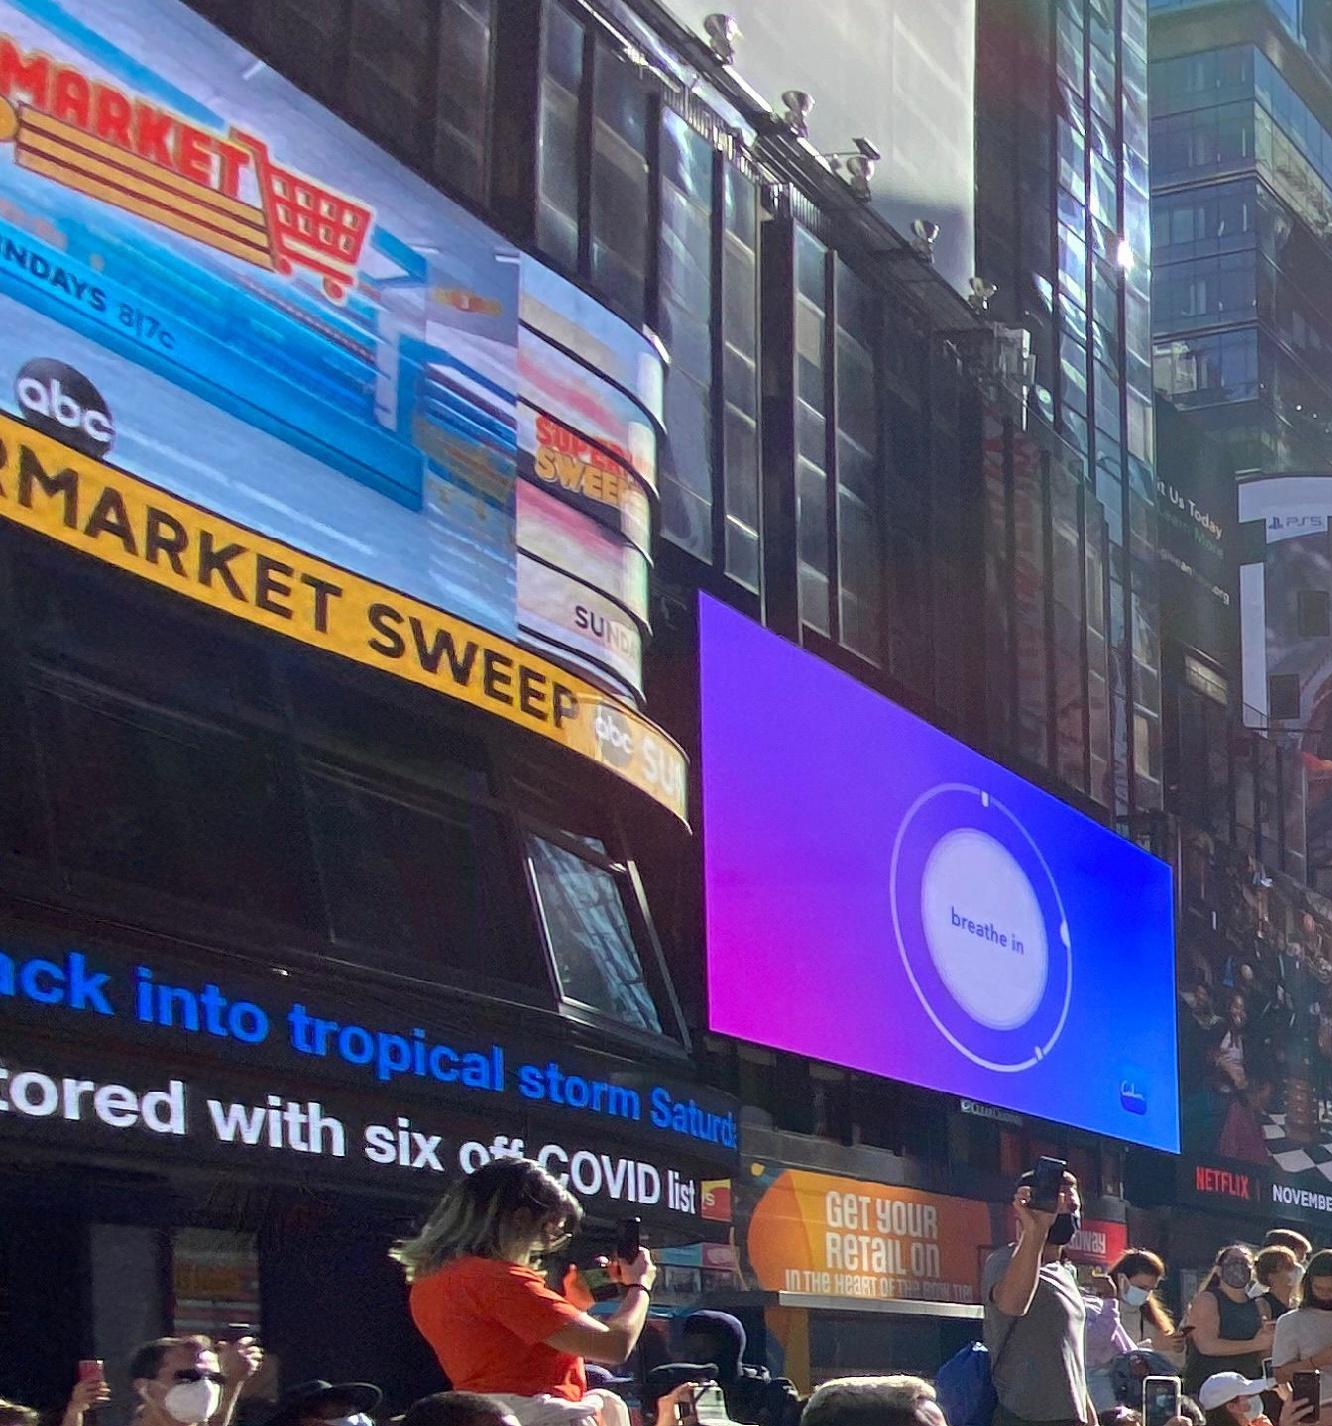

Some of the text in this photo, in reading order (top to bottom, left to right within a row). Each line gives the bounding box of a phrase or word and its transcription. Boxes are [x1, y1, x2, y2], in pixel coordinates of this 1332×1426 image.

[0, 39, 250, 198] MARKET
[17, 377, 116, 442] abc
[1189, 500, 1223, 541] Today
[0, 438, 343, 633] MARKET
[368, 603, 580, 728] SWEEP
[951, 906, 1025, 955] breathe in
[136, 964, 270, 1044] into
[288, 1003, 505, 1092] tropical
[518, 1061, 640, 1121] storm
[206, 1093, 346, 1157] with
[364, 1117, 444, 1171] six
[538, 1144, 662, 1205] COVID
[668, 1169, 697, 1214] list
[1195, 1166, 1248, 1200] NETFLIX
